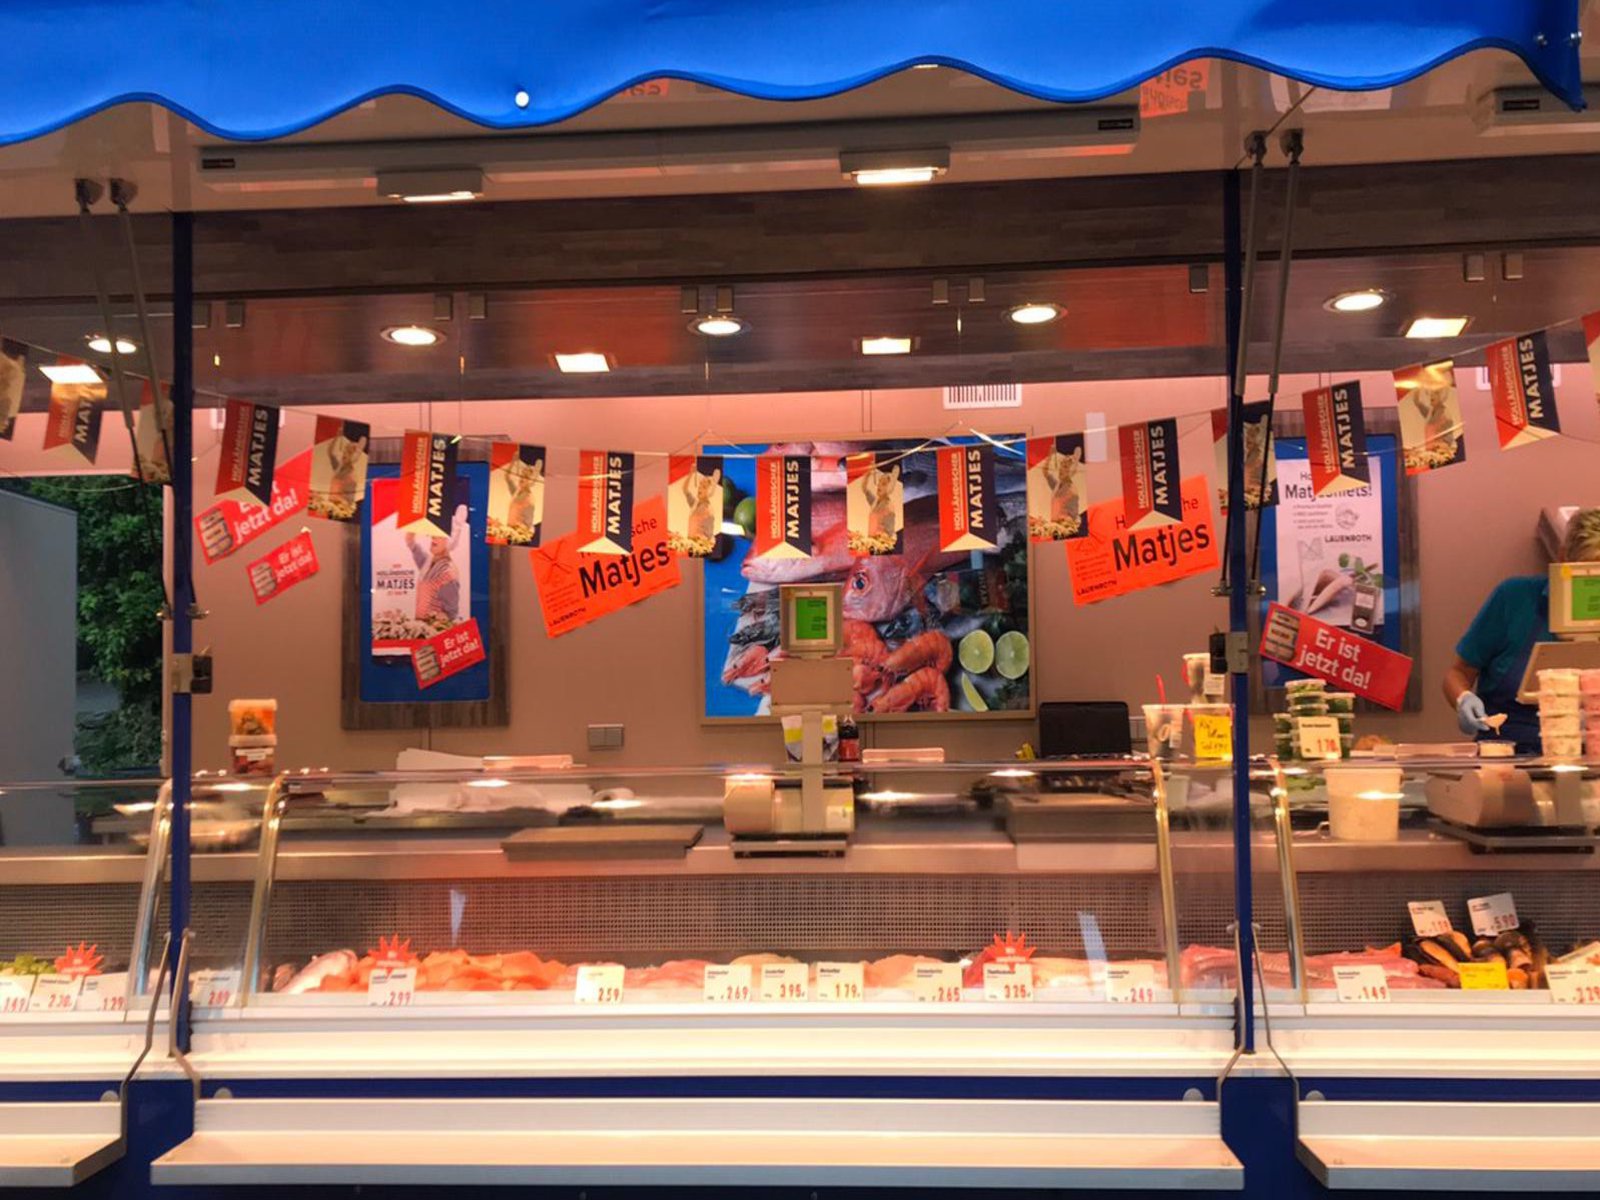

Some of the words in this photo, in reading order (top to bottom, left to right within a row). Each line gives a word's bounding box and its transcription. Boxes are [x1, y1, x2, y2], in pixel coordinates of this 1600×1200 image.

[1521, 338, 1544, 418] MATJES
[74, 399, 93, 443] MAT
[248, 408, 269, 487] MATJES
[1336, 389, 1356, 468] MATJES
[428, 439, 447, 516] MATJES
[967, 450, 983, 528] MATJES
[1149, 425, 1169, 506] MATJES
[234, 505, 272, 544] jetzt
[273, 488, 298, 517] da!
[607, 456, 622, 536] MATJES
[786, 461, 799, 539] MATJES
[275, 562, 298, 583] jetzt
[299, 551, 314, 567] da!
[278, 551, 290, 564] Er
[291, 543, 304, 558] ist
[578, 541, 670, 599] Matjes
[1112, 524, 1210, 572] Matjes
[376, 579, 415, 590] MATJES
[440, 647, 463, 668] jetzt
[463, 638, 480, 654] da!
[443, 638, 455, 650] Er
[456, 631, 469, 644] ist
[1296, 644, 1340, 677] jetzt
[1342, 665, 1372, 690] da!
[1315, 628, 1336, 650] Er
[1338, 636, 1361, 663] ist
